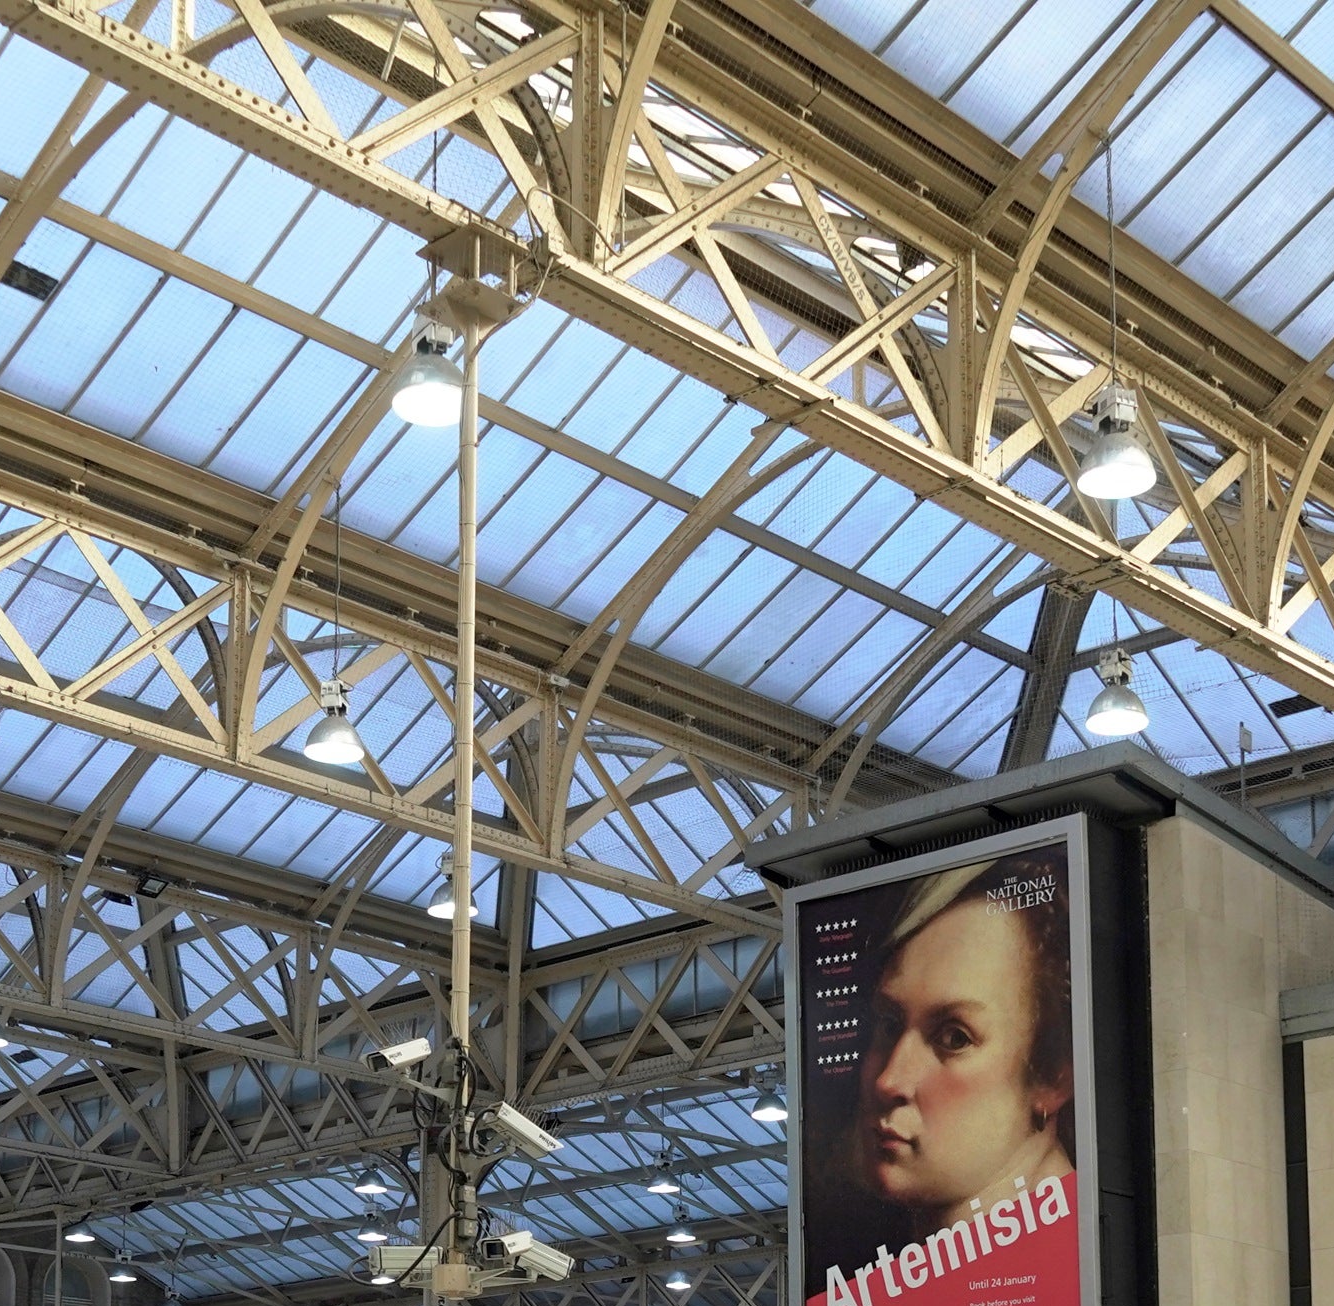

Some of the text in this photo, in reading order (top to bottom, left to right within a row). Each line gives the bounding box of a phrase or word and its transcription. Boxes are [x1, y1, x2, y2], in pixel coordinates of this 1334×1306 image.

[986, 875, 1056, 901] NATIONAL
[1004, 876, 1017, 885] THE
[986, 887, 1056, 916] GALLERY
[969, 1275, 1036, 1291] Until 24 January
[1009, 1298, 1021, 1306] you
[1023, 1295, 1035, 1303] visit
